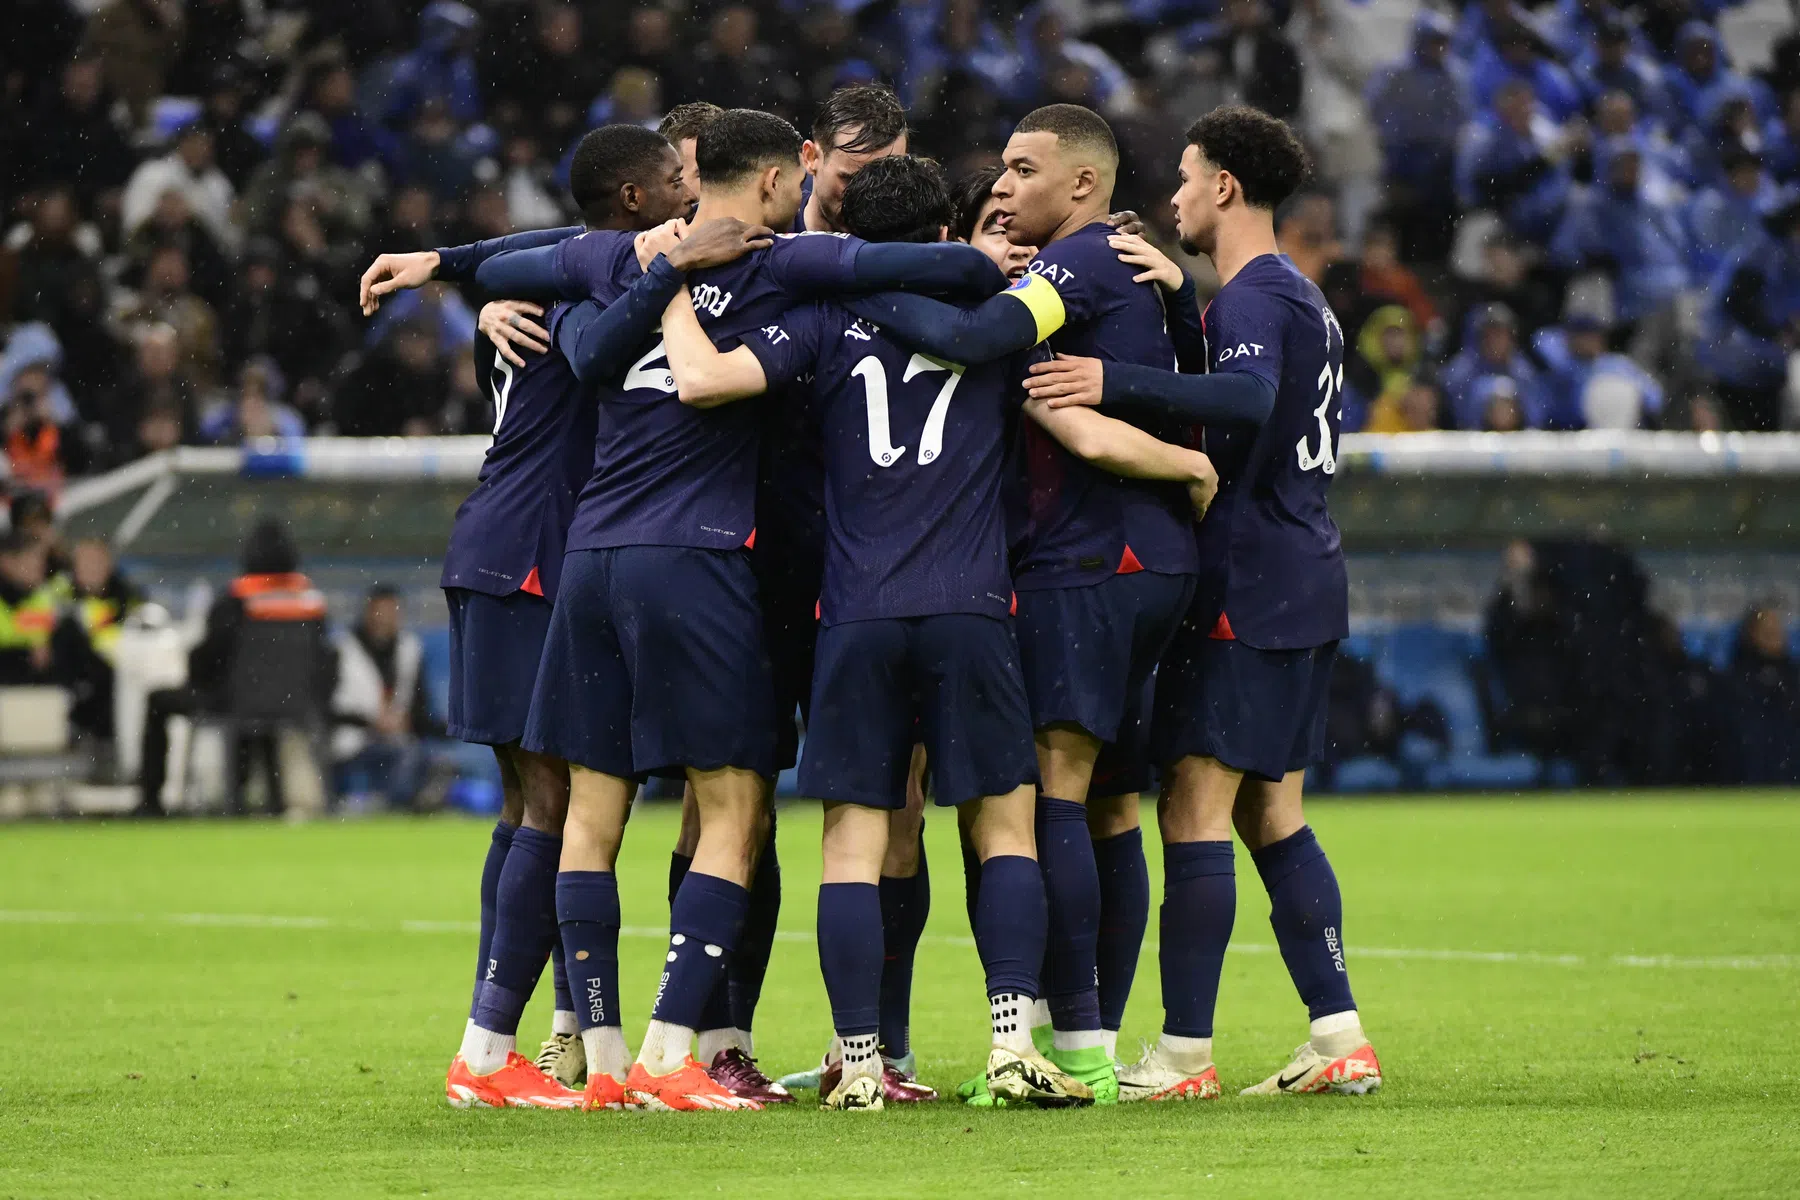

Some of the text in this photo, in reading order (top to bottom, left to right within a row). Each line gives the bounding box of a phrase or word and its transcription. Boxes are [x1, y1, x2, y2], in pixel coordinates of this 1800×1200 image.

[1026, 259, 1075, 285] OAT
[760, 325, 790, 345] AT
[1214, 343, 1264, 369] OAT
[851, 352, 967, 467] 17
[1324, 926, 1346, 972] PARIS
[485, 958, 498, 985] PA
[586, 977, 605, 1023] PARIS
